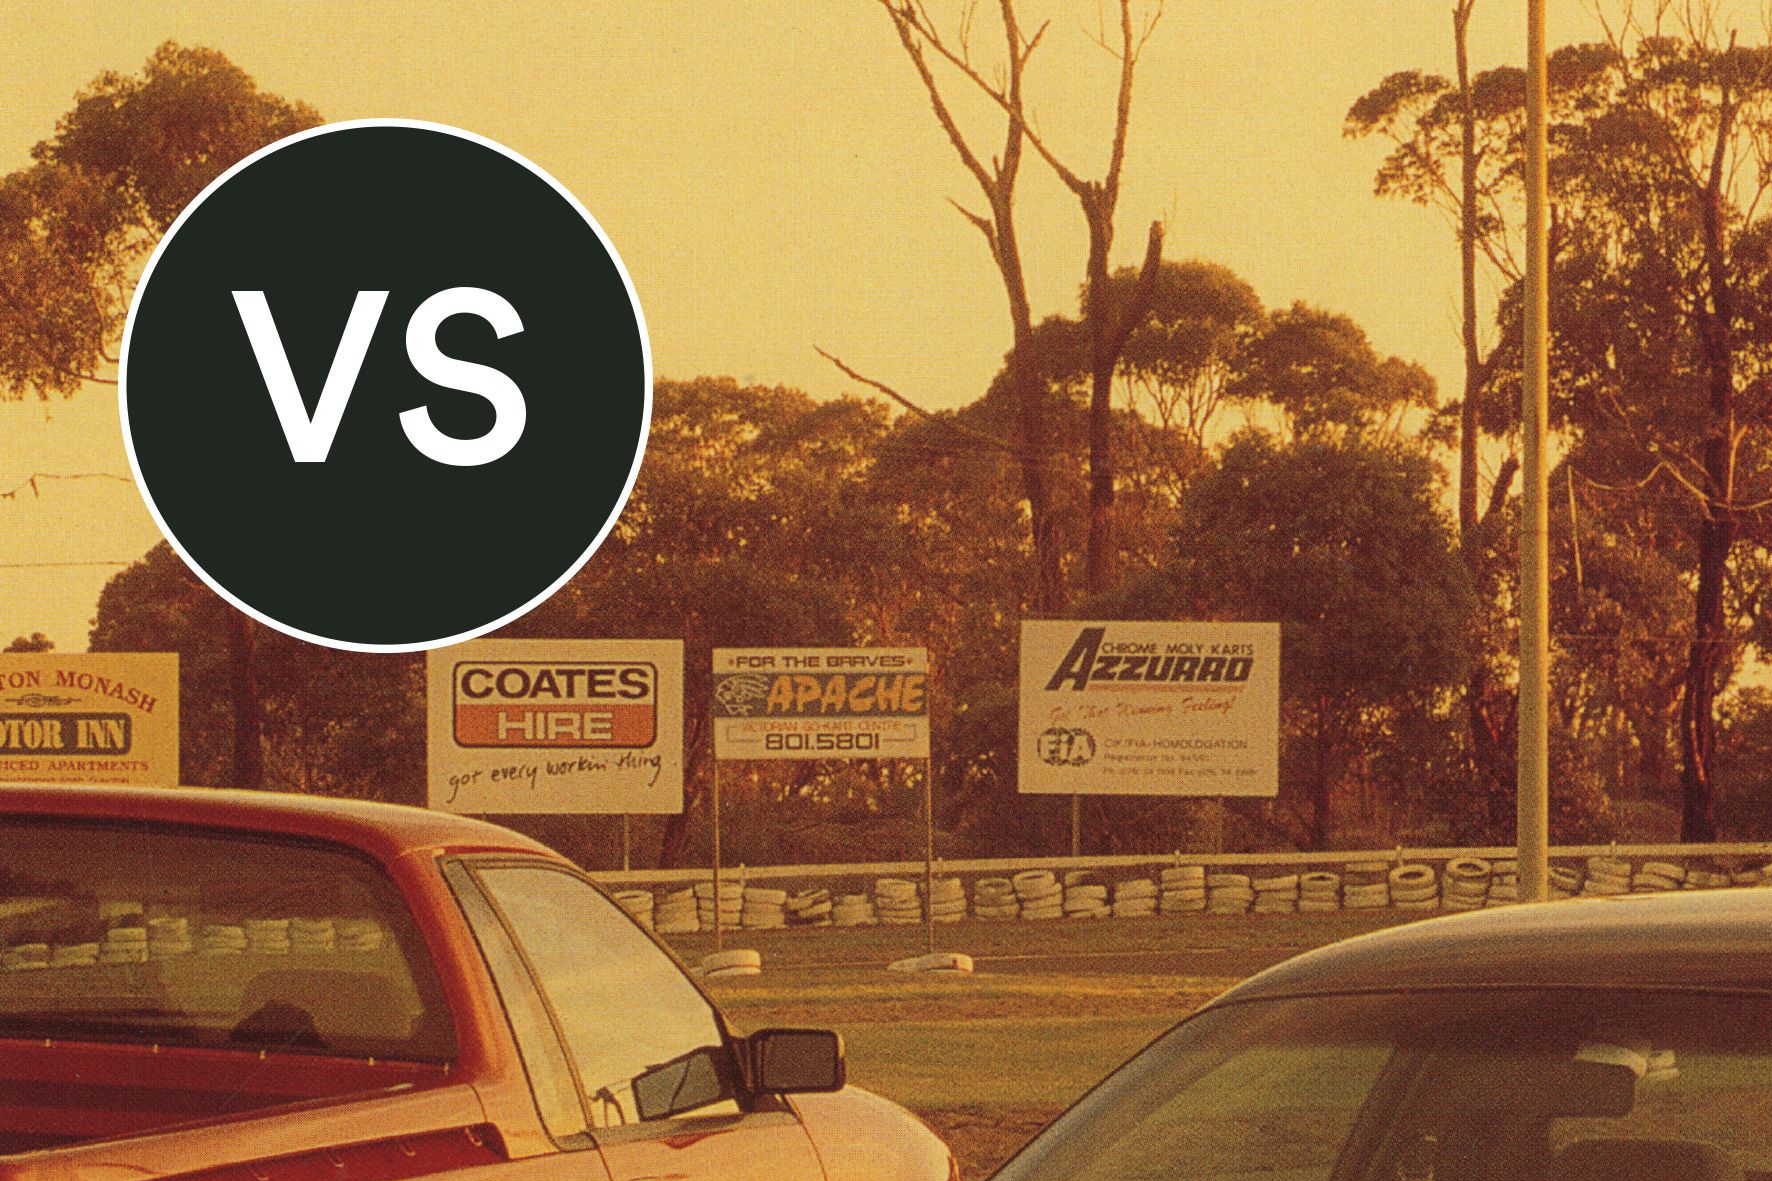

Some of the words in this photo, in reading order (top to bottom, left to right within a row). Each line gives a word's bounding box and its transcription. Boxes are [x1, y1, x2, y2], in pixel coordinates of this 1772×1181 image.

[736, 656, 776, 667] FOR
[782, 656, 820, 667] THE
[826, 655, 905, 667] BRAVES
[1101, 643, 1157, 655] CHROME
[1166, 642, 1204, 655] MOLY
[1211, 642, 1254, 655] KARTS
[55, 670, 158, 713] MONASH
[460, 667, 650, 699] COATES
[766, 674, 926, 713] APACHE
[76, 719, 126, 749] INN
[497, 711, 613, 740] HIRE
[765, 733, 880, 751] 801.5801
[0, 760, 40, 771] ICED
[50, 760, 149, 771] APARTMENTS
[490, 765, 538, 789] every
